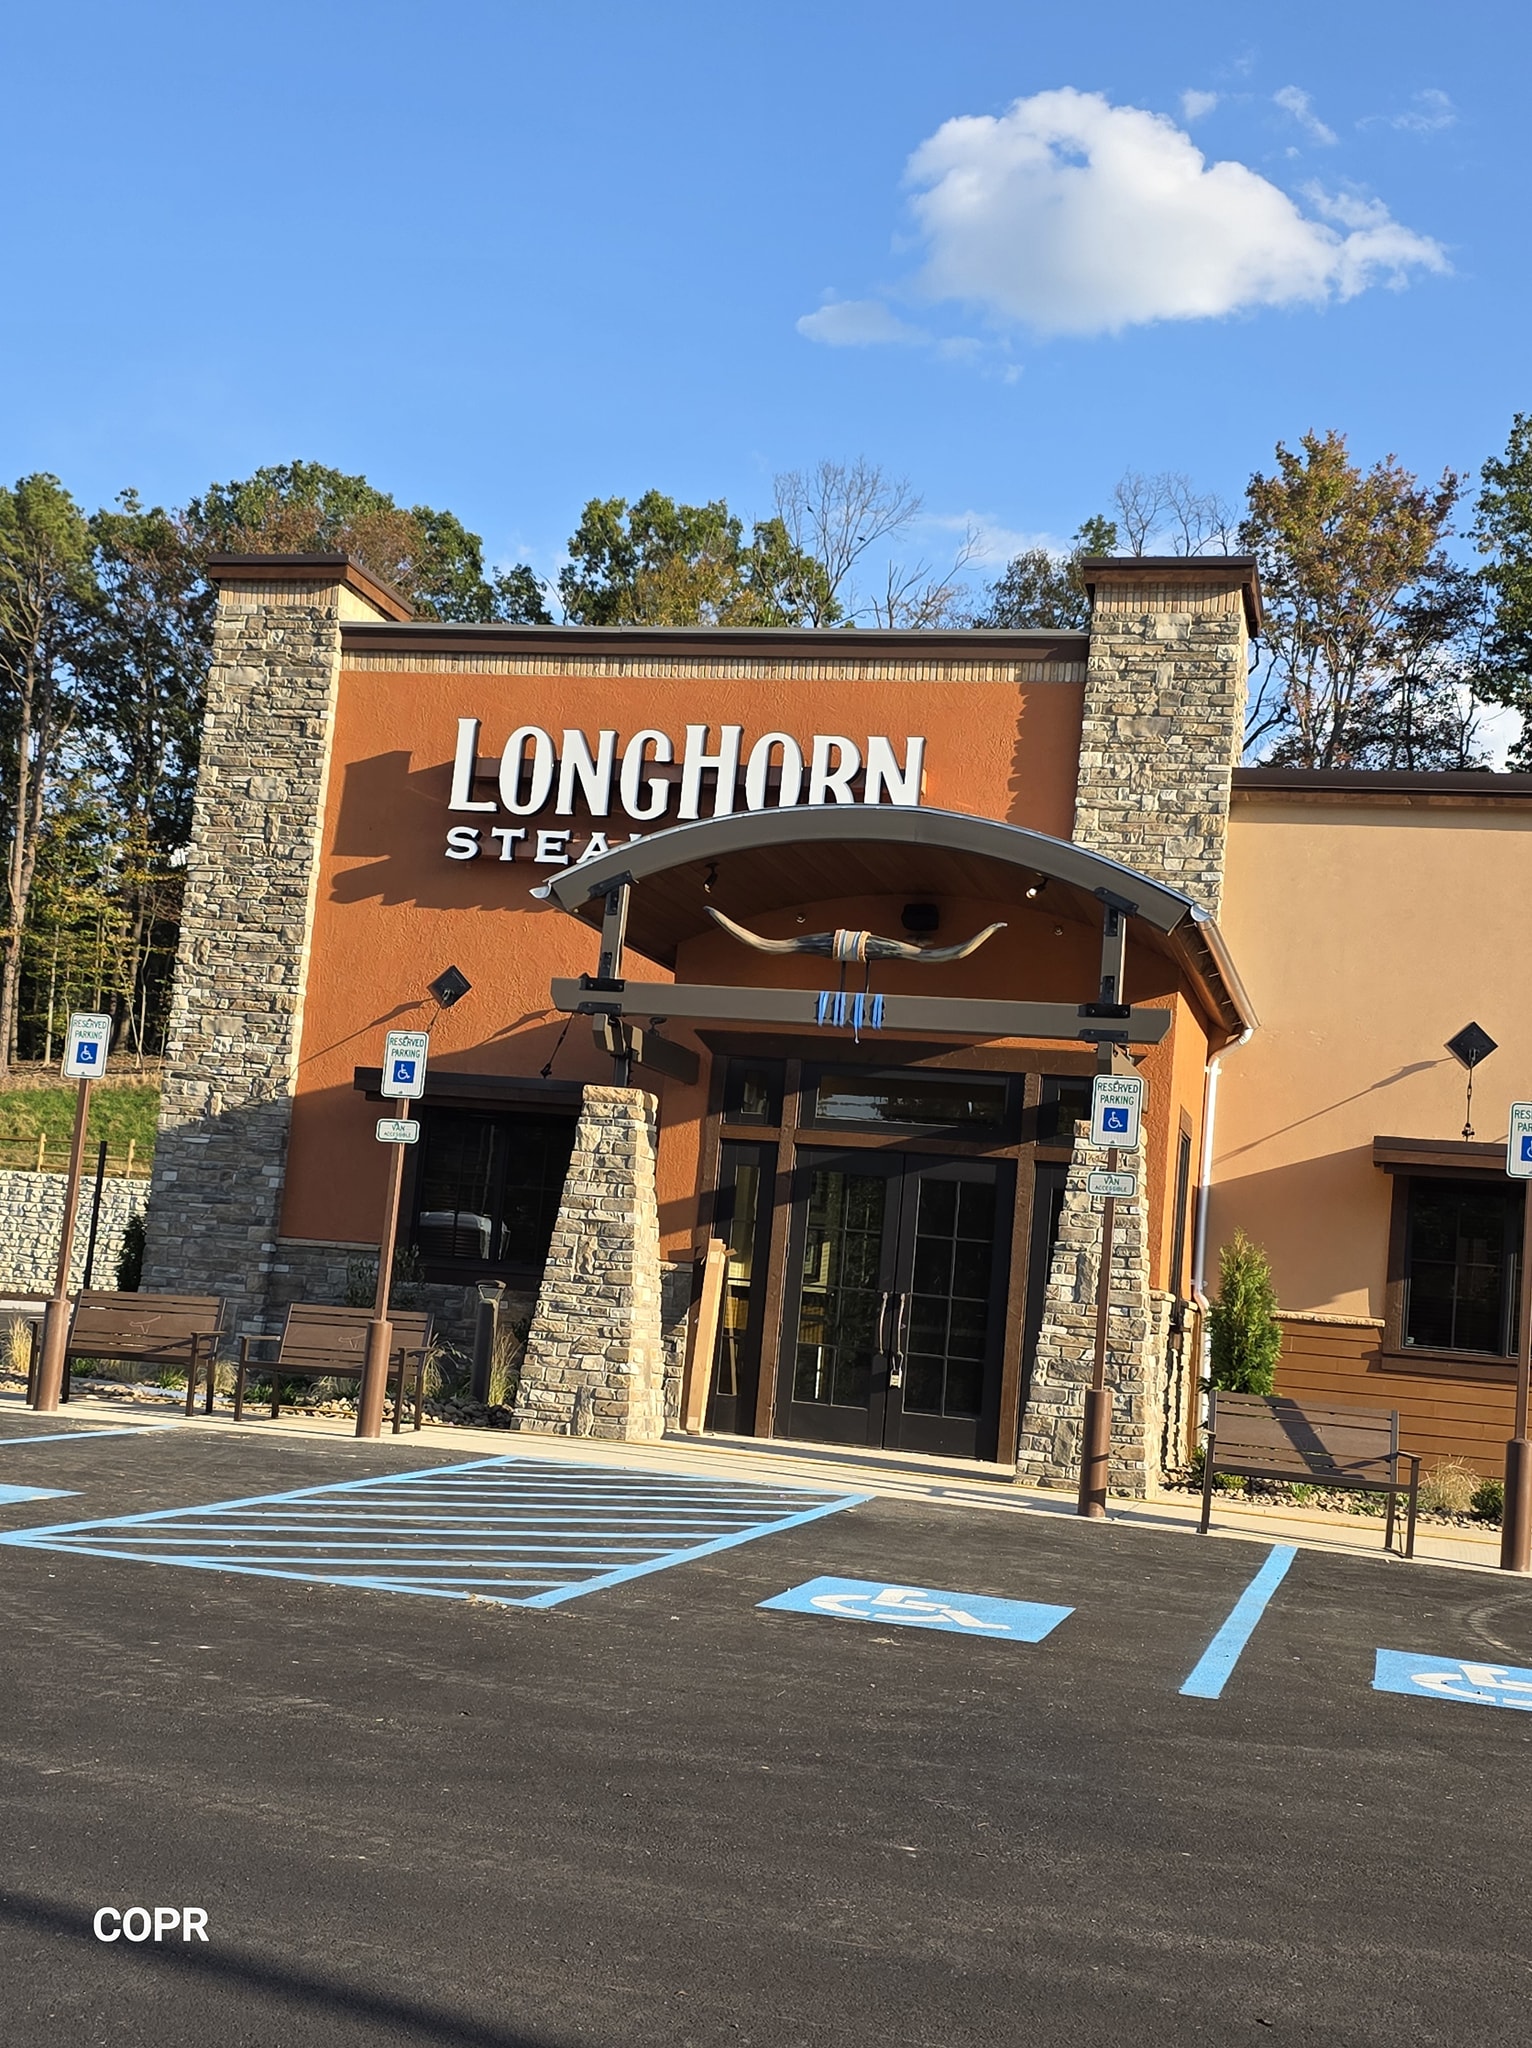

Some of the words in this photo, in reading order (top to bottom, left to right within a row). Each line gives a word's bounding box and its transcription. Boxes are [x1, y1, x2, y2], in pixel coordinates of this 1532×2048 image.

[447, 717, 926, 821] LONGHORN
[445, 825, 642, 864] STEA
[73, 1019, 106, 1029] RESERVED
[75, 1030, 102, 1039] PARKING
[389, 1037, 424, 1047] RESERVED
[391, 1048, 421, 1058] PARKING
[1097, 1082, 1138, 1093] RESERVED
[1100, 1094, 1135, 1106] PARKING
[1514, 1109, 1532, 1119] RES
